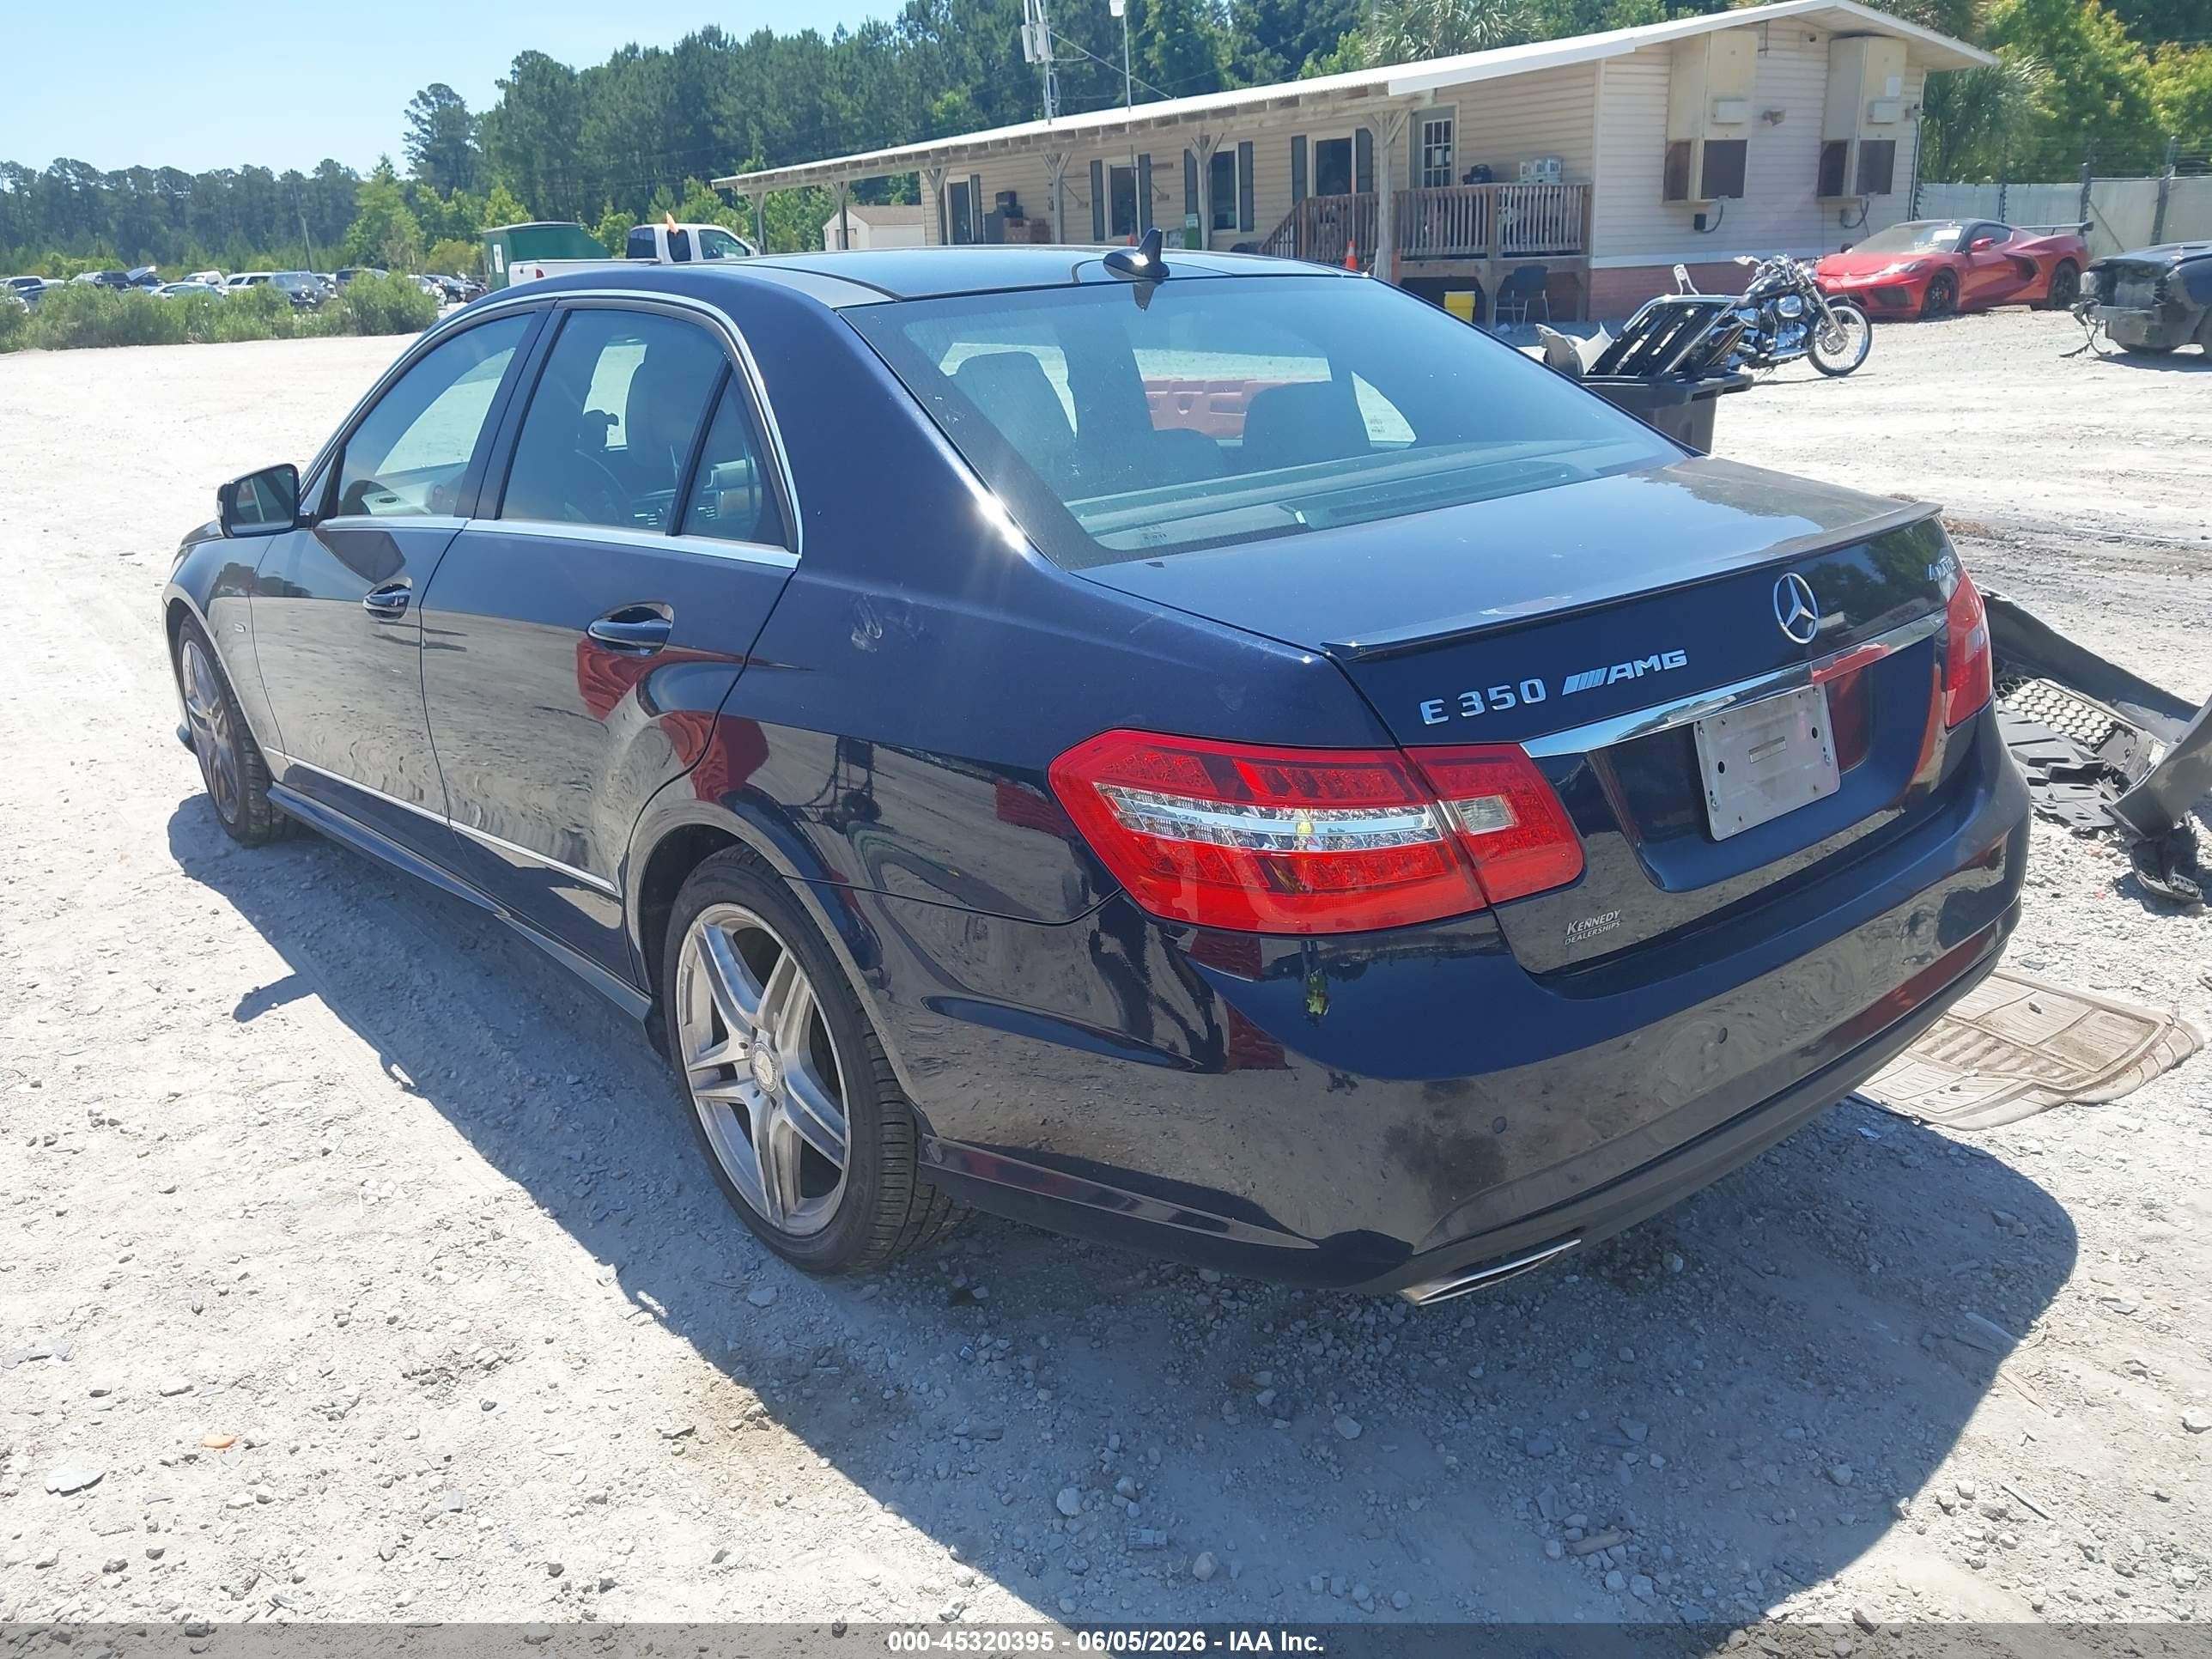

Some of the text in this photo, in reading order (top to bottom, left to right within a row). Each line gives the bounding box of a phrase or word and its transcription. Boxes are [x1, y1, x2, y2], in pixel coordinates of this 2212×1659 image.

[1419, 649, 1688, 726] E 350 AMG
[1565, 921, 1621, 945] DEALERSHIPS
[1566, 908, 1621, 936] KENNEDY
